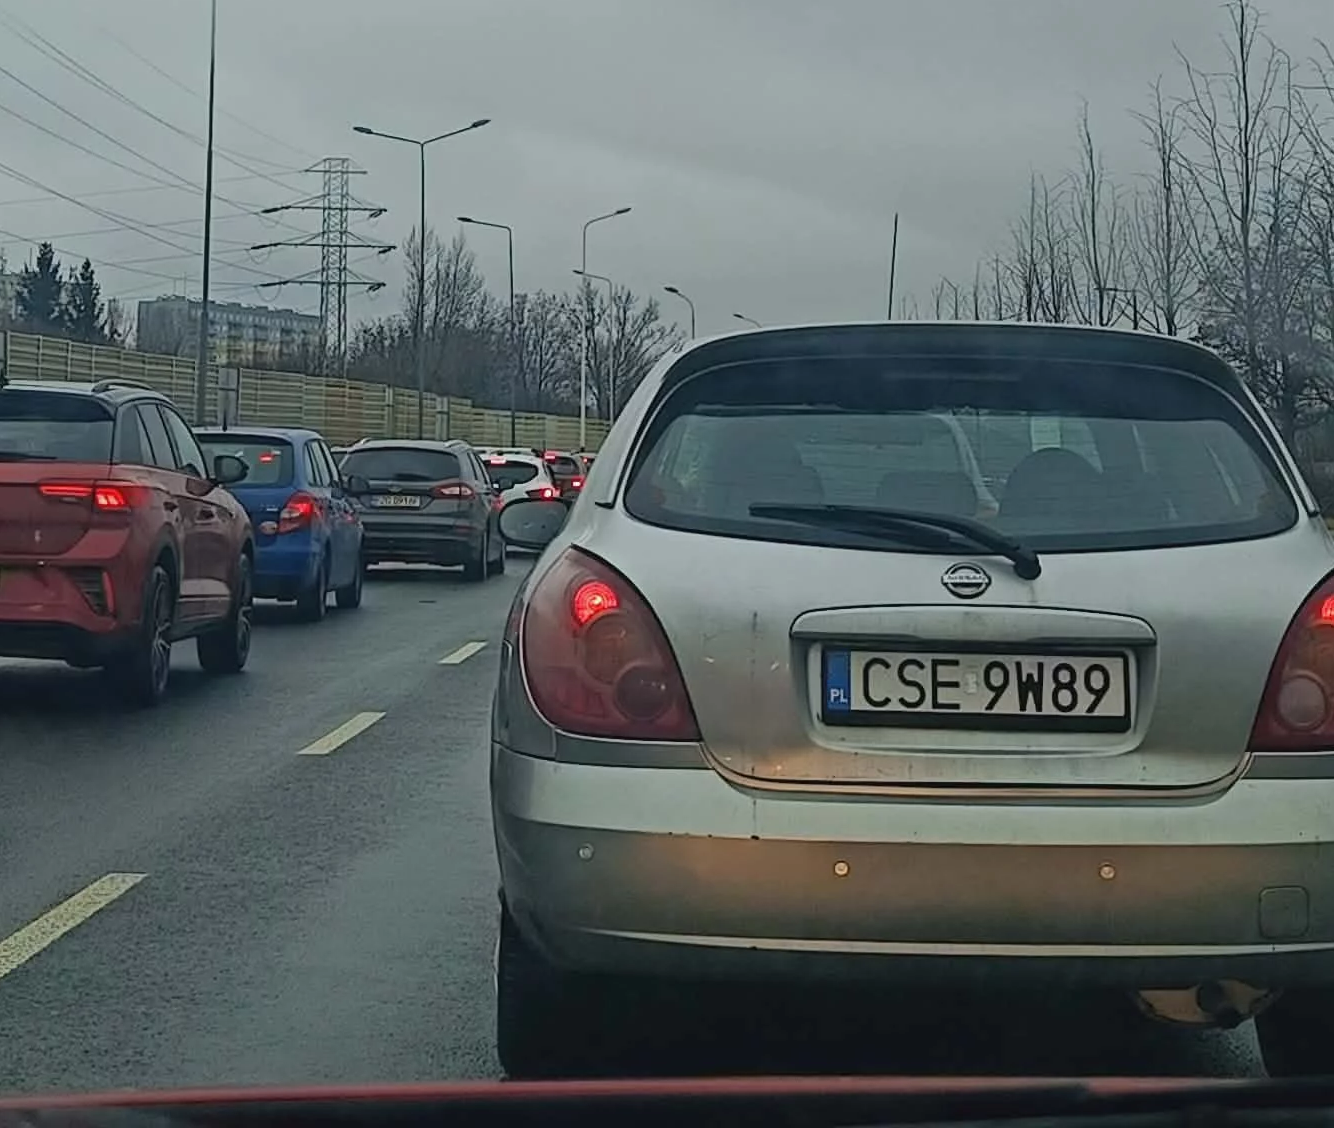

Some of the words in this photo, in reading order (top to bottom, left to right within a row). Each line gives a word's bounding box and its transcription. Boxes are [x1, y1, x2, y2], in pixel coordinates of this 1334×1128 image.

[829, 688, 848, 703] PL
[862, 657, 961, 710] CSE
[983, 660, 1111, 714] 9W89
